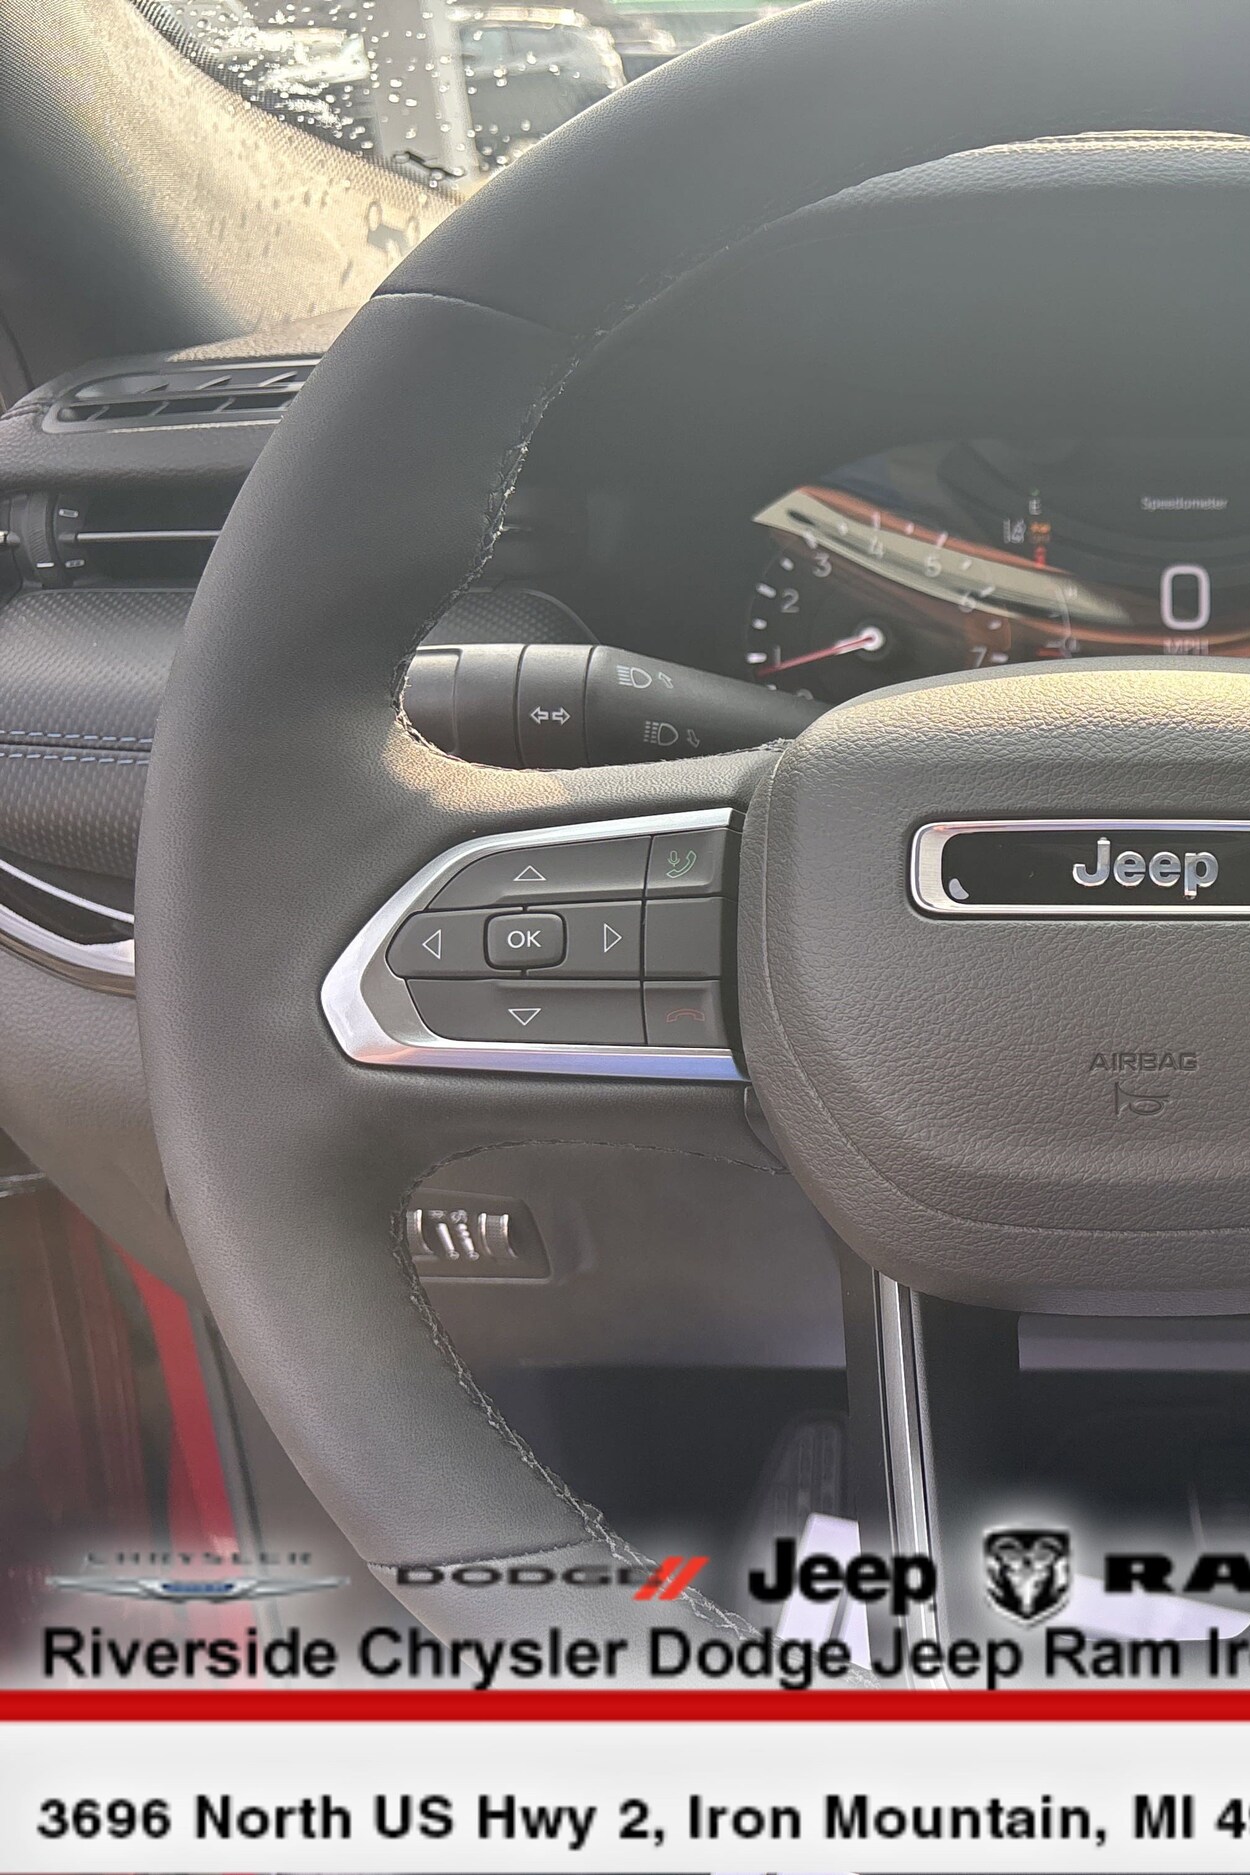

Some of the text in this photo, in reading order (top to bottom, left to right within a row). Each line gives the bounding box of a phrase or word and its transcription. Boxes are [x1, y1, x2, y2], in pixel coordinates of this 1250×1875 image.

[812, 554, 832, 578] 3
[924, 555, 943, 578] 5
[780, 588, 800, 613] 2
[1072, 836, 1220, 900] Jeep
[507, 930, 542, 949] OK
[1088, 1051, 1198, 1073] AIRBAG
